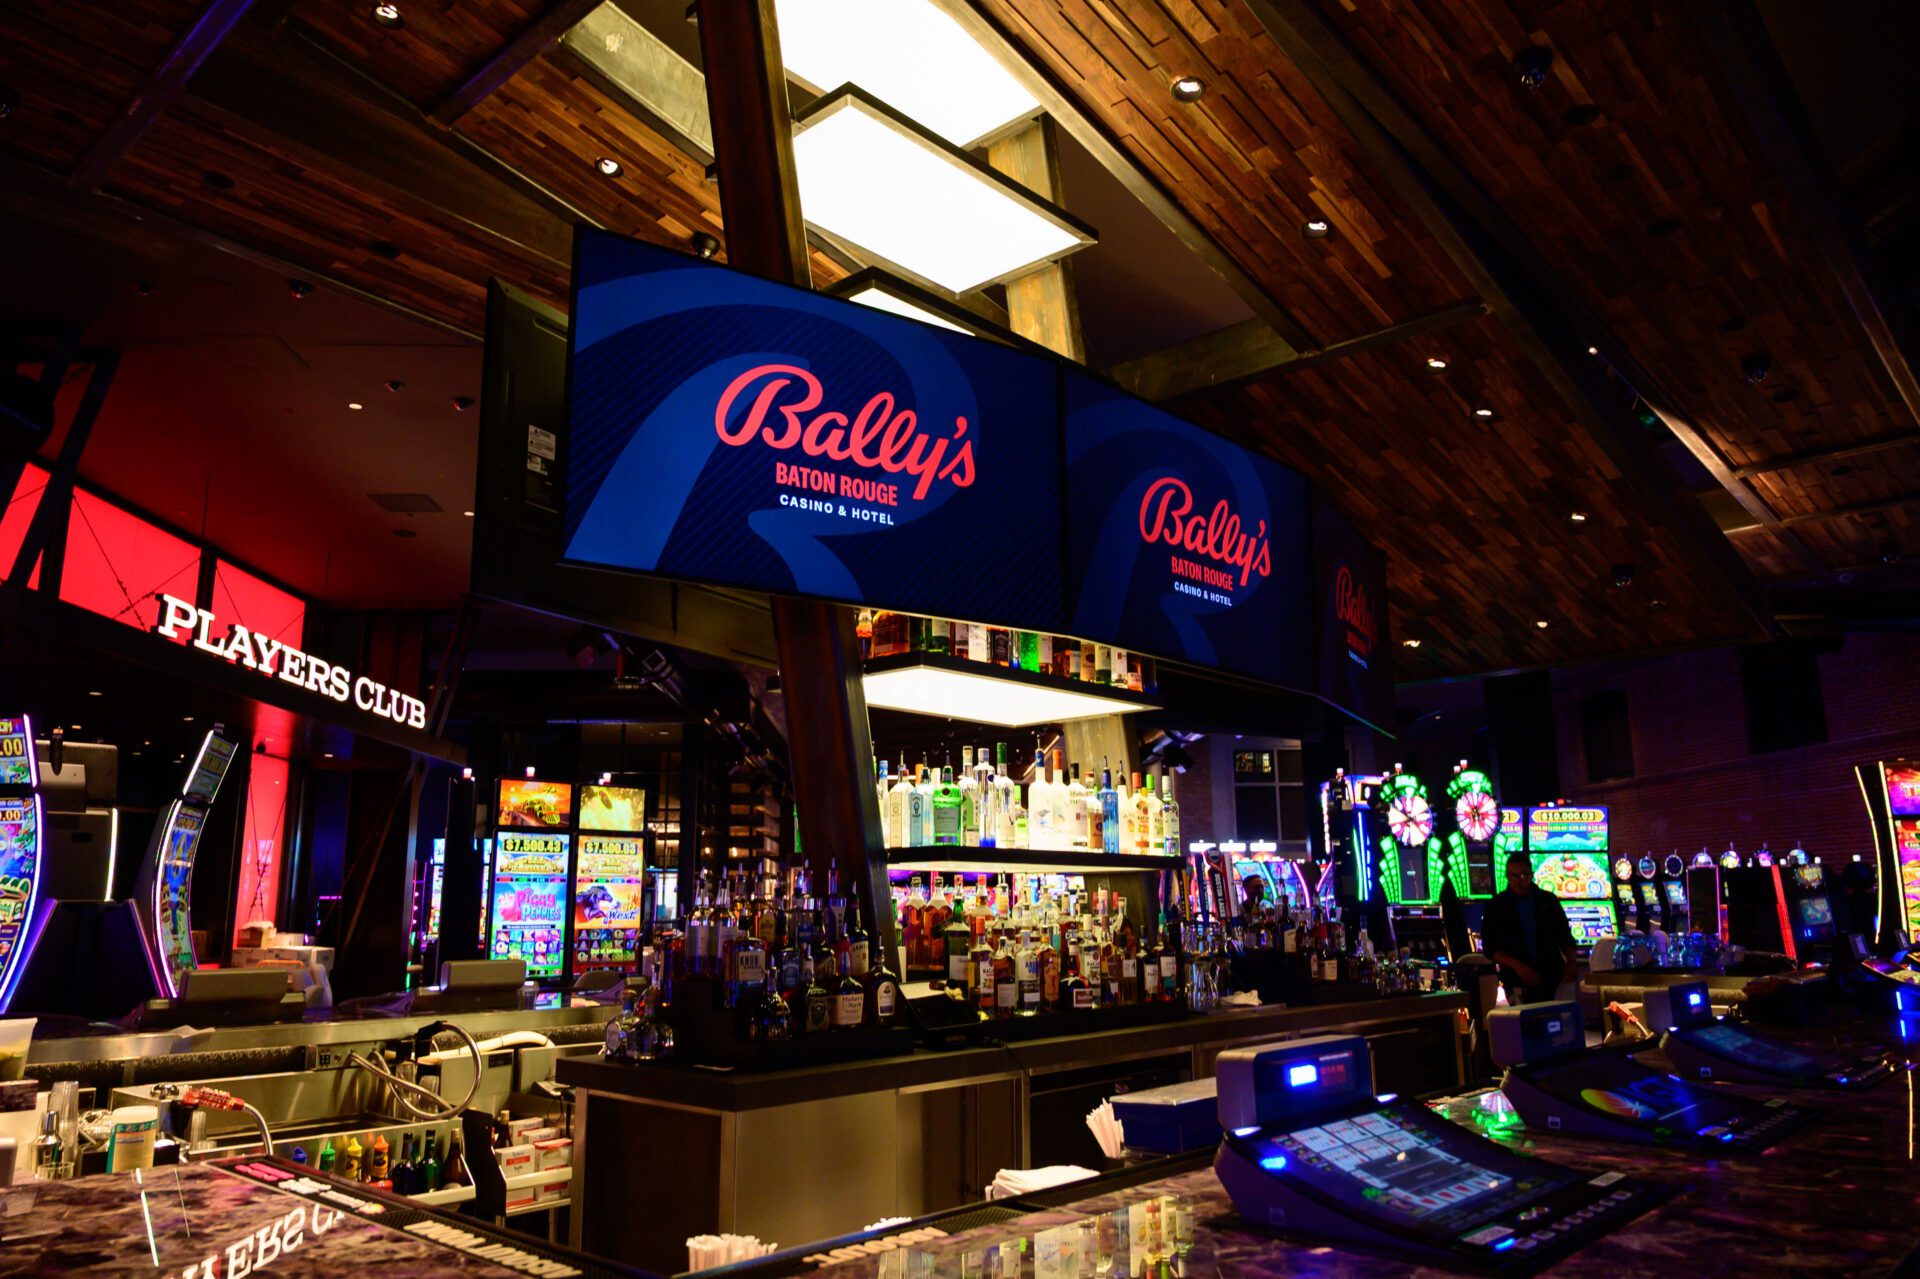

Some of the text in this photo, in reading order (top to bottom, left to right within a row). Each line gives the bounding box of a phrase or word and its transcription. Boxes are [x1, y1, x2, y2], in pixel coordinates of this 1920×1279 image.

[715, 363, 976, 500] Bally's
[776, 462, 899, 507] BATON ROUGE
[779, 494, 895, 526] CASINO & HOTEL
[1139, 476, 1272, 587] Bally's
[1171, 556, 1234, 592] BATON ROUGE
[1174, 581, 1232, 607] CASINO & HOTEL
[157, 593, 426, 730] PLAYERS CLUB
